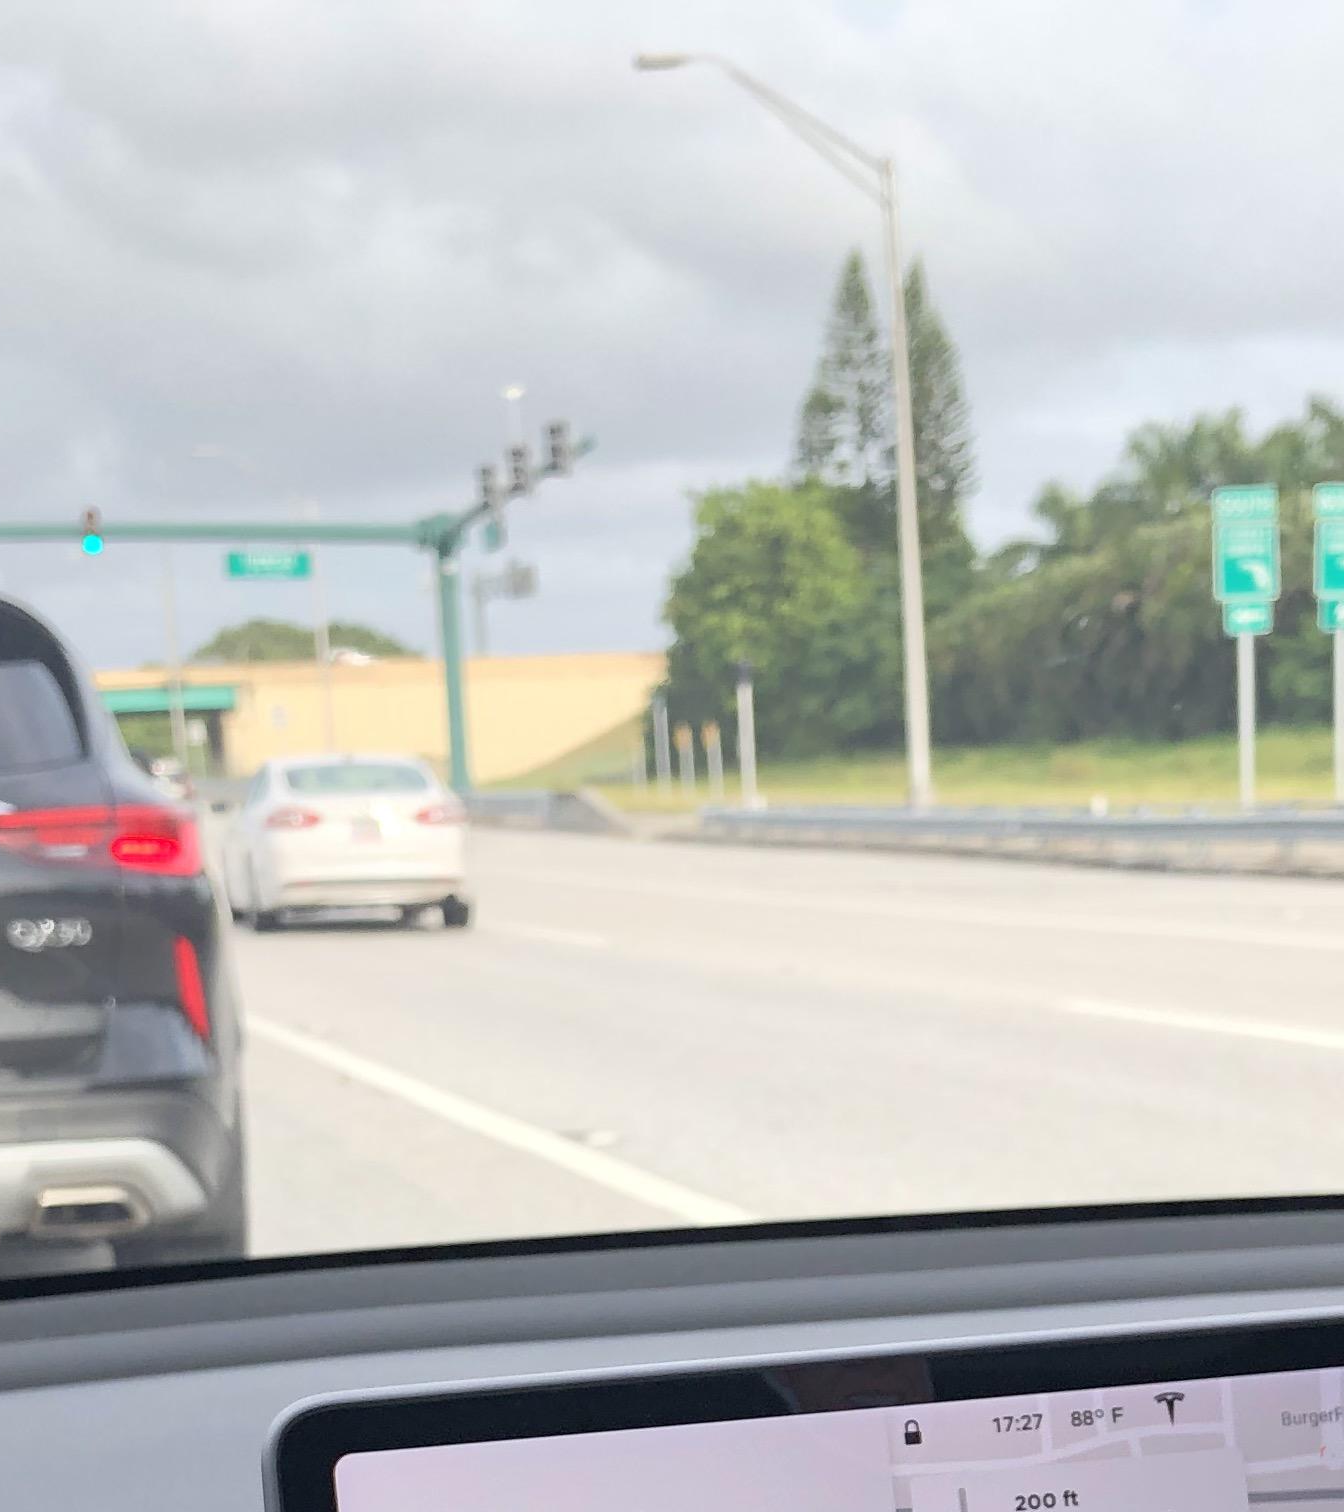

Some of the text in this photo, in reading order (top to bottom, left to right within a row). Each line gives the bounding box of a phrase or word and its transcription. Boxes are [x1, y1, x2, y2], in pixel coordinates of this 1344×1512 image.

[992, 1413, 1043, 1433] 17:27
[1112, 1406, 1124, 1423] F
[1015, 1490, 1079, 1511] 200 ft
